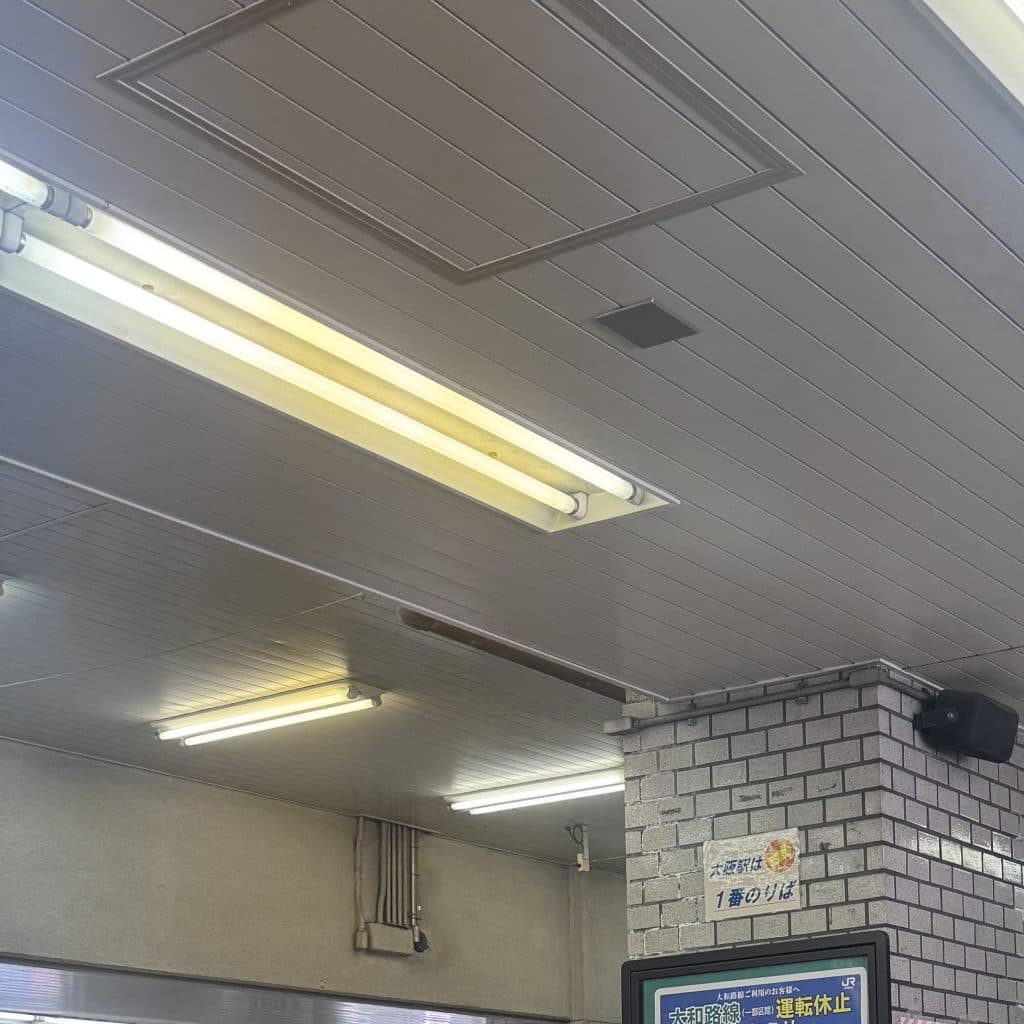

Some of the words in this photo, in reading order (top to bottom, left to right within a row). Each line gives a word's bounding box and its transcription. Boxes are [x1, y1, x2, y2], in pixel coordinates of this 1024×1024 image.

[709, 856, 763, 878] 大阪駅は
[716, 880, 797, 908] 1番のりば
[841, 977, 856, 987] JR
[776, 991, 851, 1018] 運転休止
